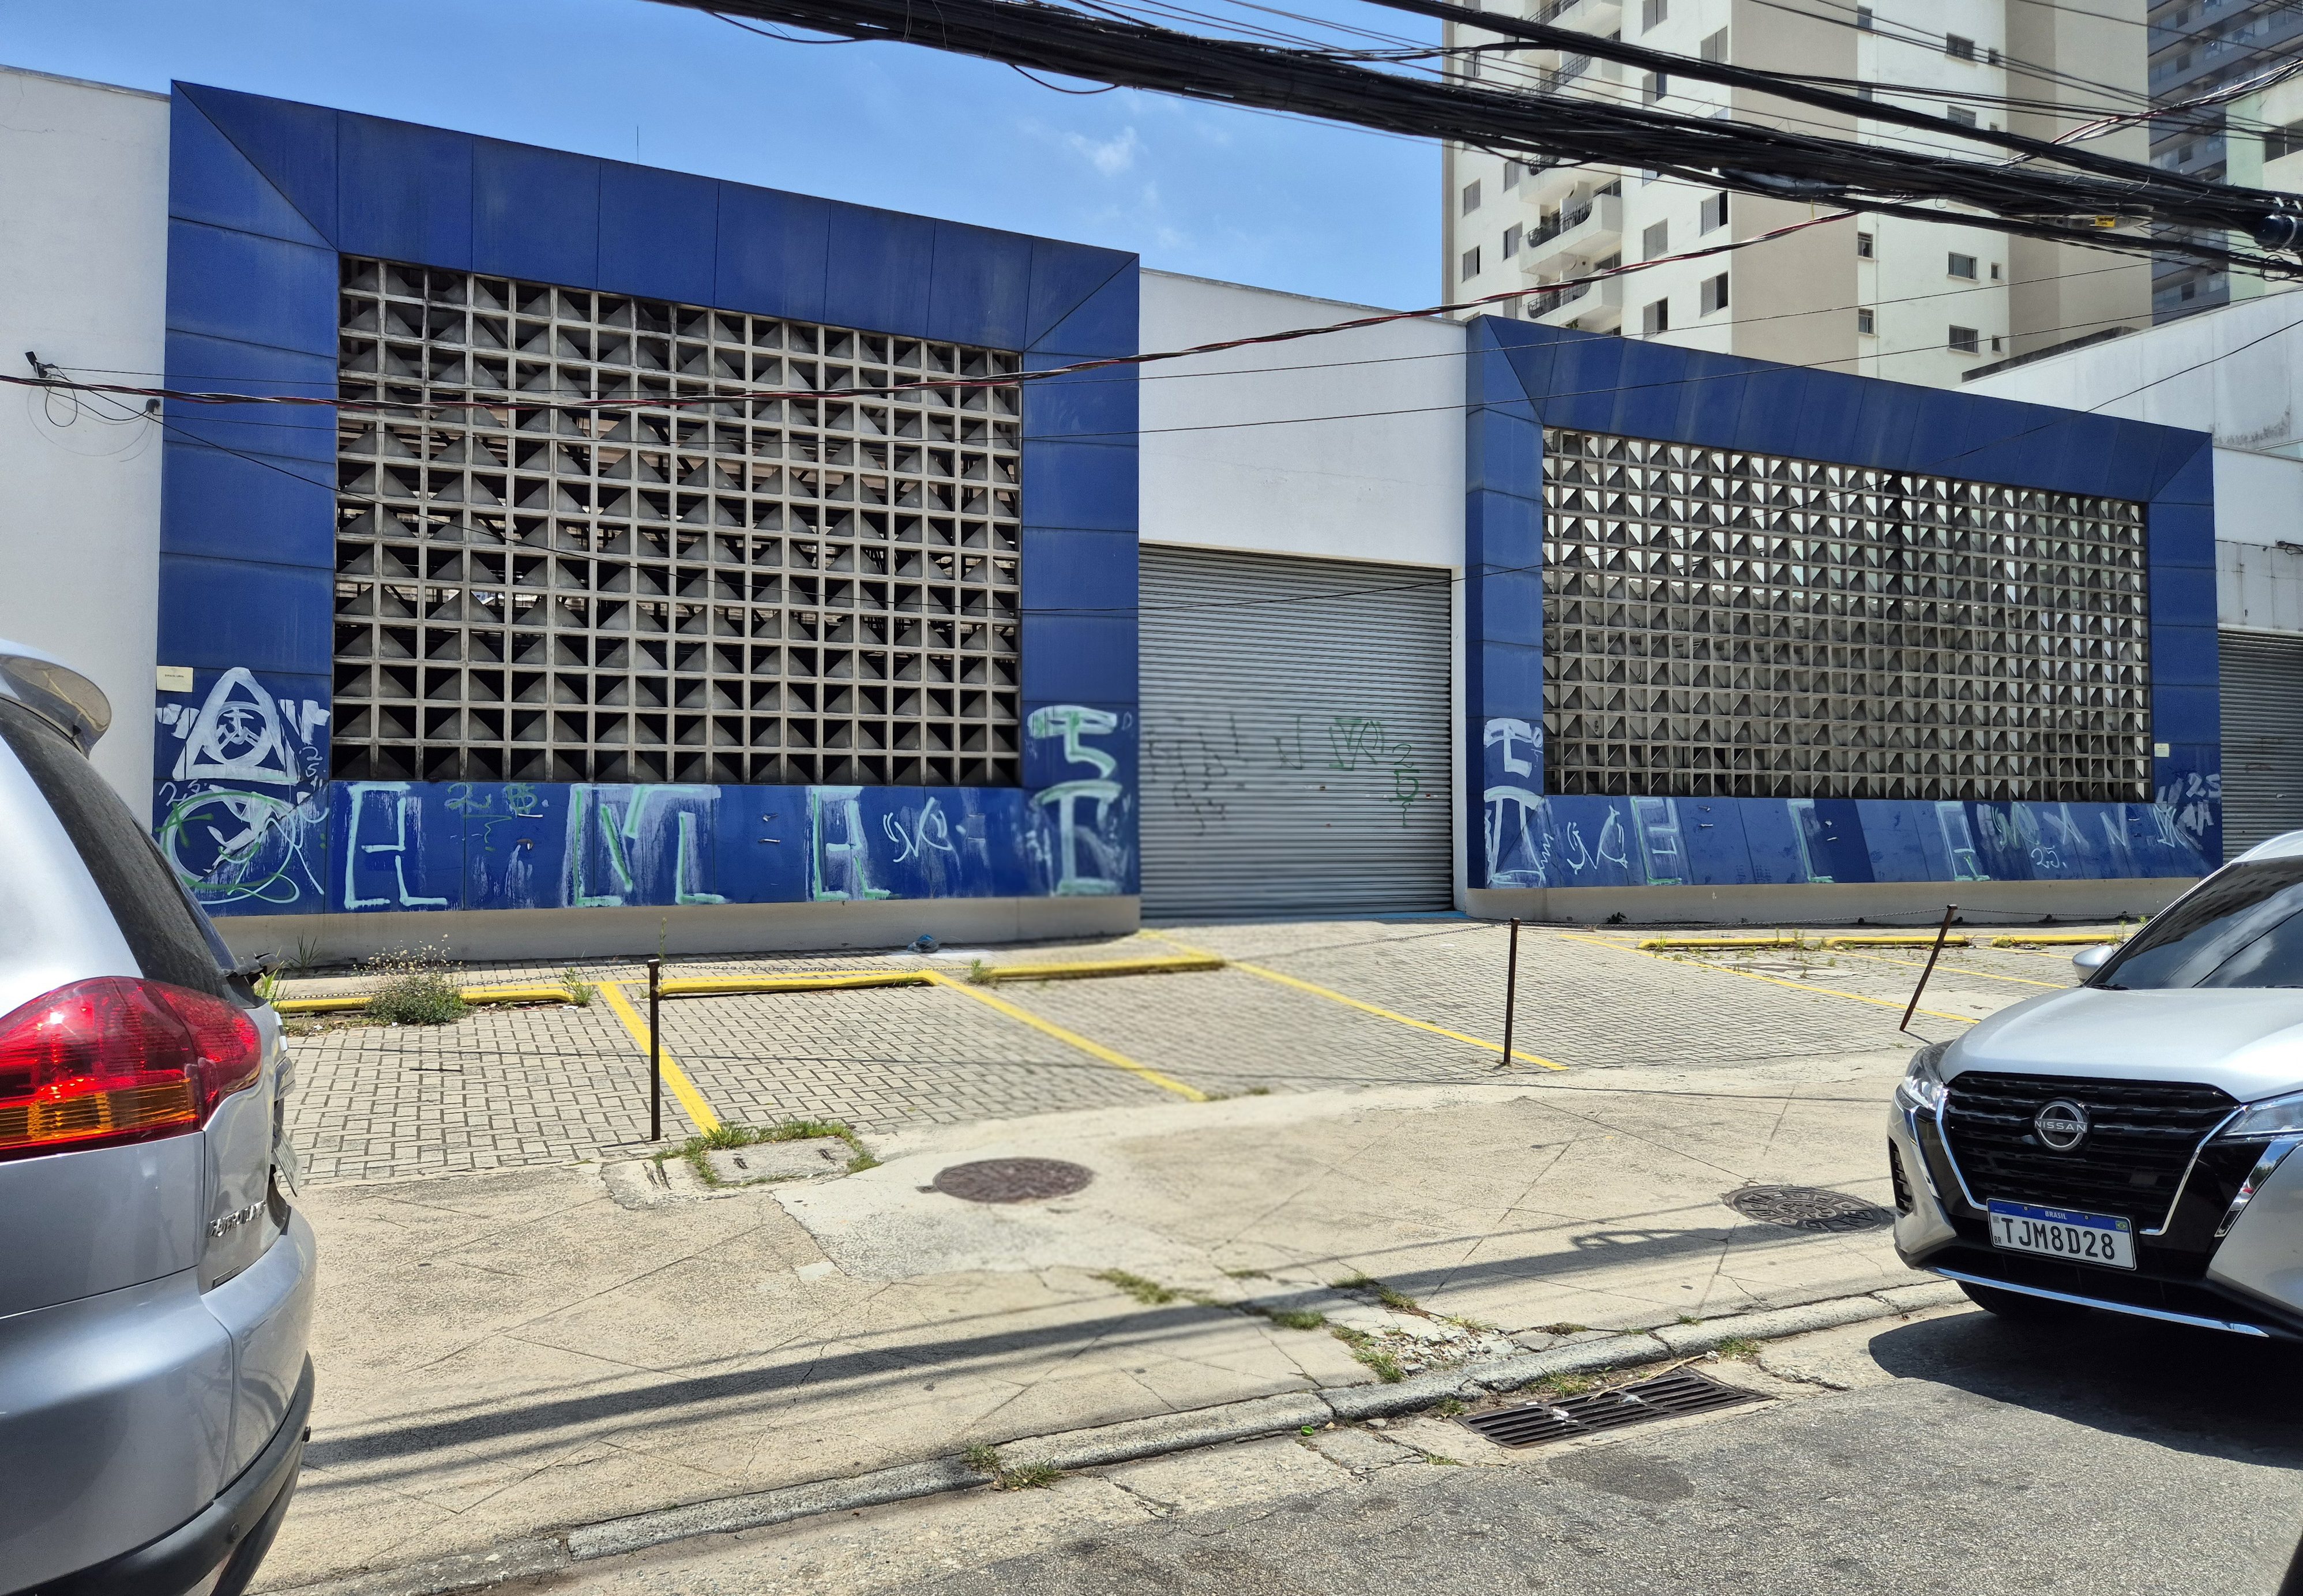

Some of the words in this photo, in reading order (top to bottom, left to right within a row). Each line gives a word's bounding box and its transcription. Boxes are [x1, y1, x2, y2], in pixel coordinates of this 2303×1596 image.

[2034, 1120, 2086, 1132] NISSAN
[2045, 1211, 2068, 1220] BRASIL
[1994, 1236, 2002, 1245] BR
[2001, 1218, 2115, 1260] TJM8D28
